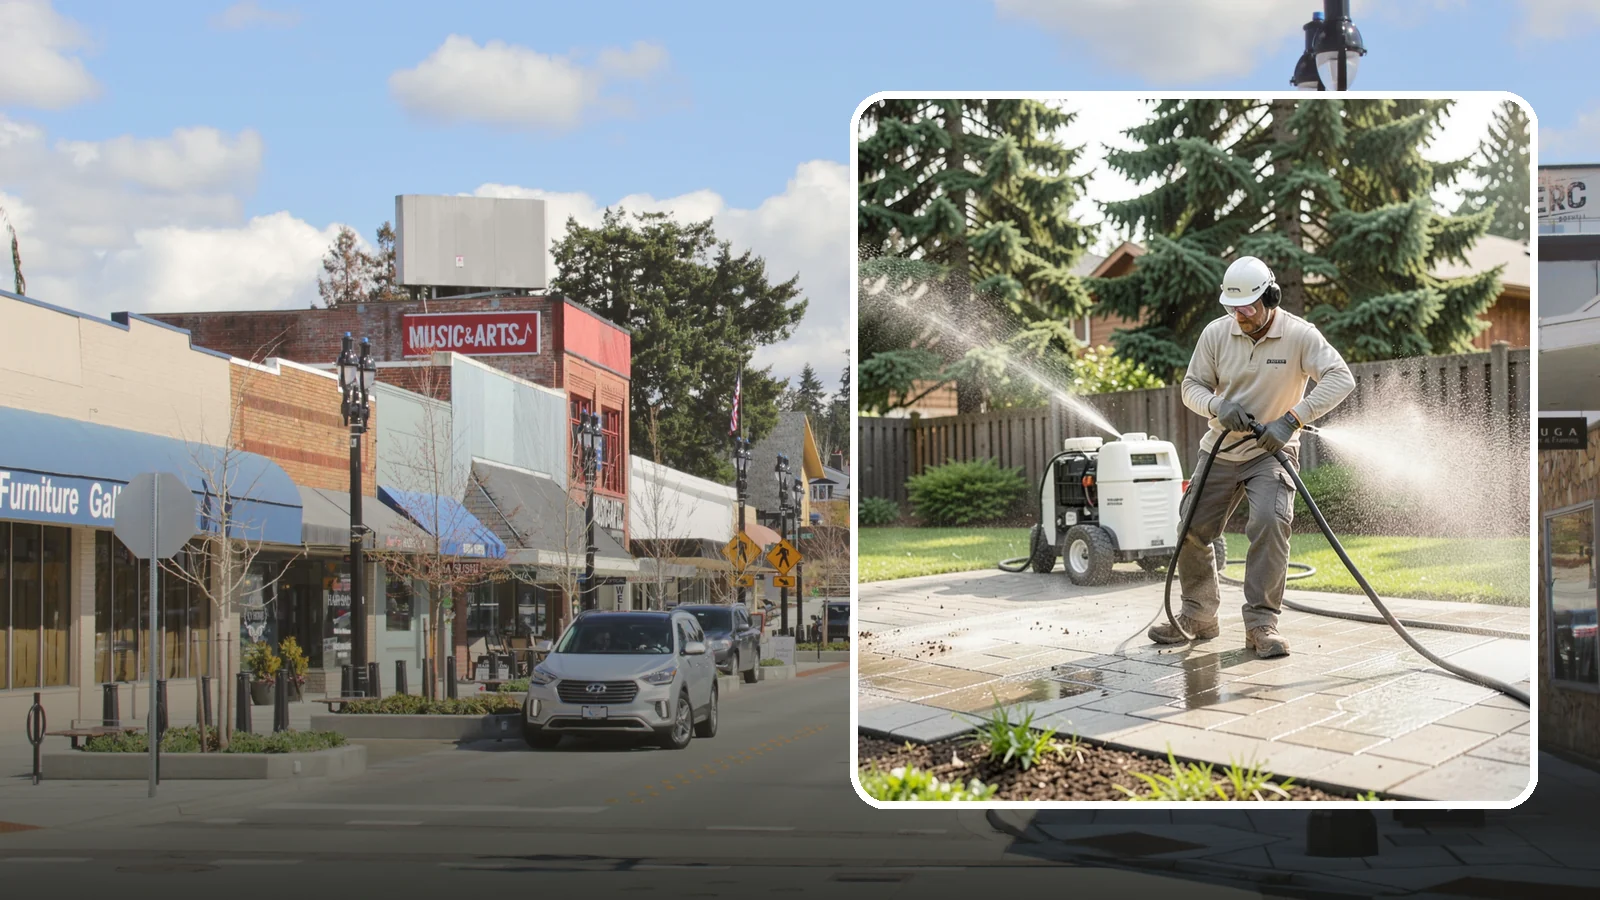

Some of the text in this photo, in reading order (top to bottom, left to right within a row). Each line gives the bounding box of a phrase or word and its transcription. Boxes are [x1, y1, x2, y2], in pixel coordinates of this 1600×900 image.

[1540, 428, 1577, 436] UGA
[0, 472, 121, 518] Furniture Gal
[454, 563, 479, 574] SUSHI
